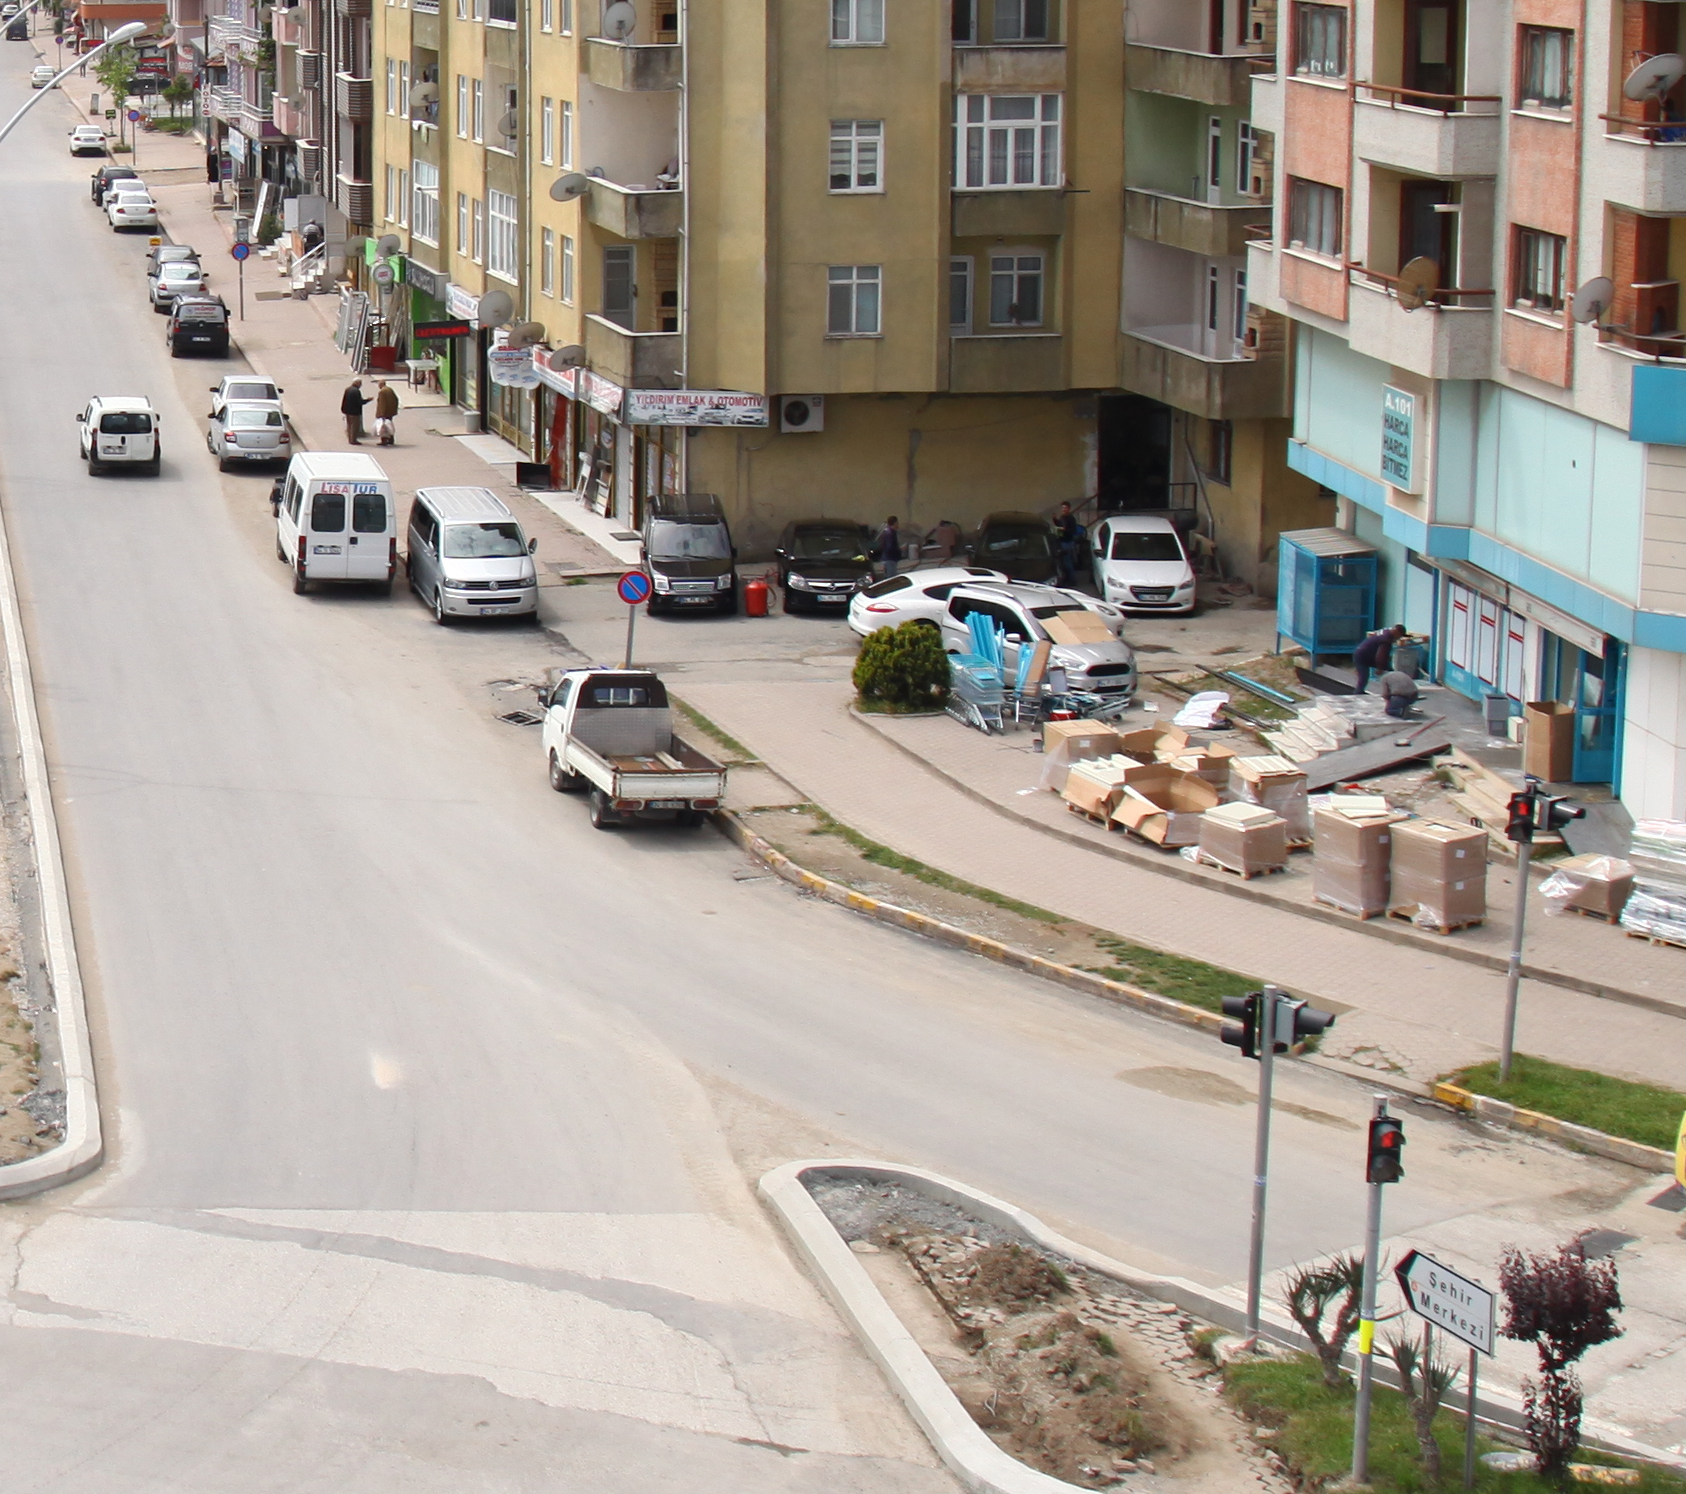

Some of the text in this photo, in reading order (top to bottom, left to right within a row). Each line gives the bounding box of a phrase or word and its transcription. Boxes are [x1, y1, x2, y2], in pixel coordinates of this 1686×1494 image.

[676, 395, 707, 406] EMLAK
[1384, 412, 1409, 438] HARCA
[1383, 434, 1409, 461] HARCA
[1429, 1271, 1473, 1306] Şehir
[1420, 1291, 1484, 1341] Merkezi
